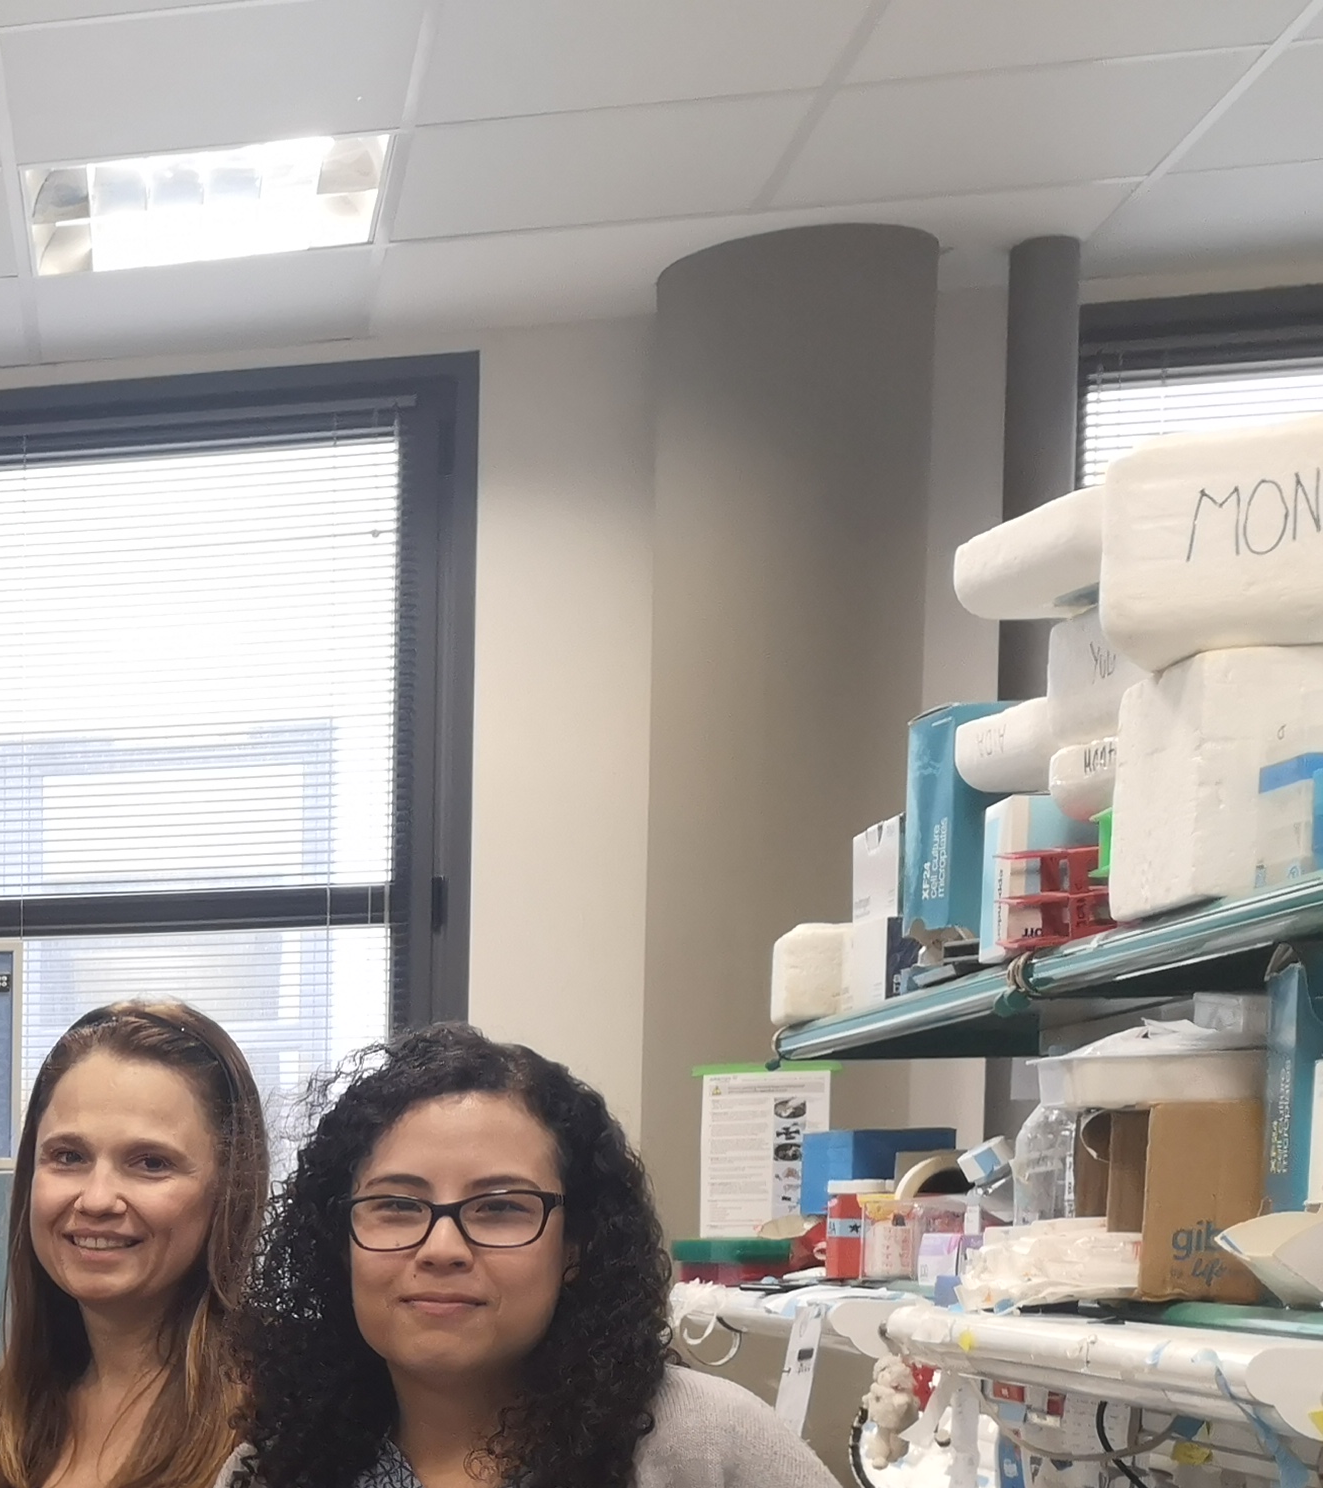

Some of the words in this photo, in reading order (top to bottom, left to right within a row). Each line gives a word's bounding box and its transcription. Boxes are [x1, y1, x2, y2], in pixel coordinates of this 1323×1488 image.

[931, 824, 940, 872] culture
[938, 817, 948, 898] microplates
[922, 862, 932, 901] XF24
[930, 875, 938, 899] cell
[1171, 1219, 1222, 1261] gib
